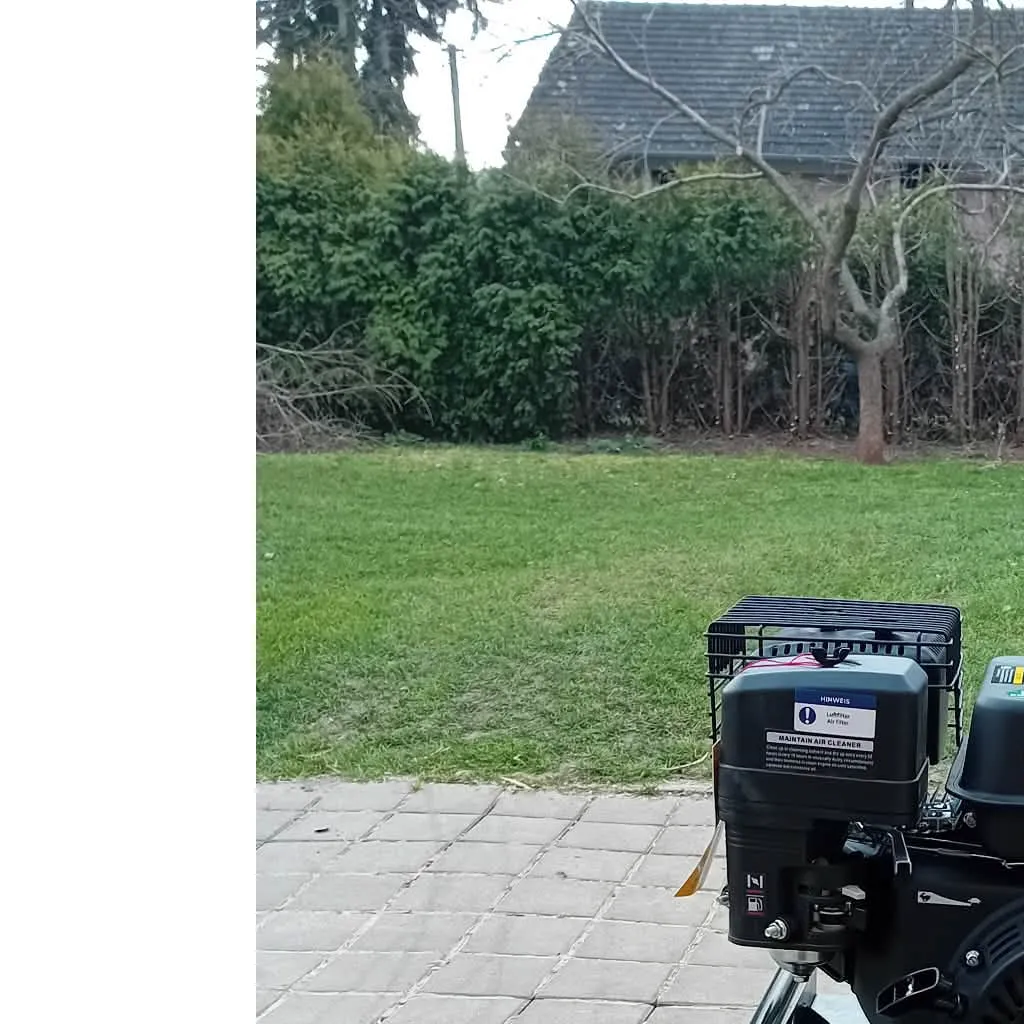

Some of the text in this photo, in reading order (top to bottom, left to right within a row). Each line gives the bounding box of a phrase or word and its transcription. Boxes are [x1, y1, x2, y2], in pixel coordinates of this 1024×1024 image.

[820, 695, 851, 705] HINWEIS
[778, 735, 813, 744] MAINTAIN
[828, 739, 862, 749] CLEANER
